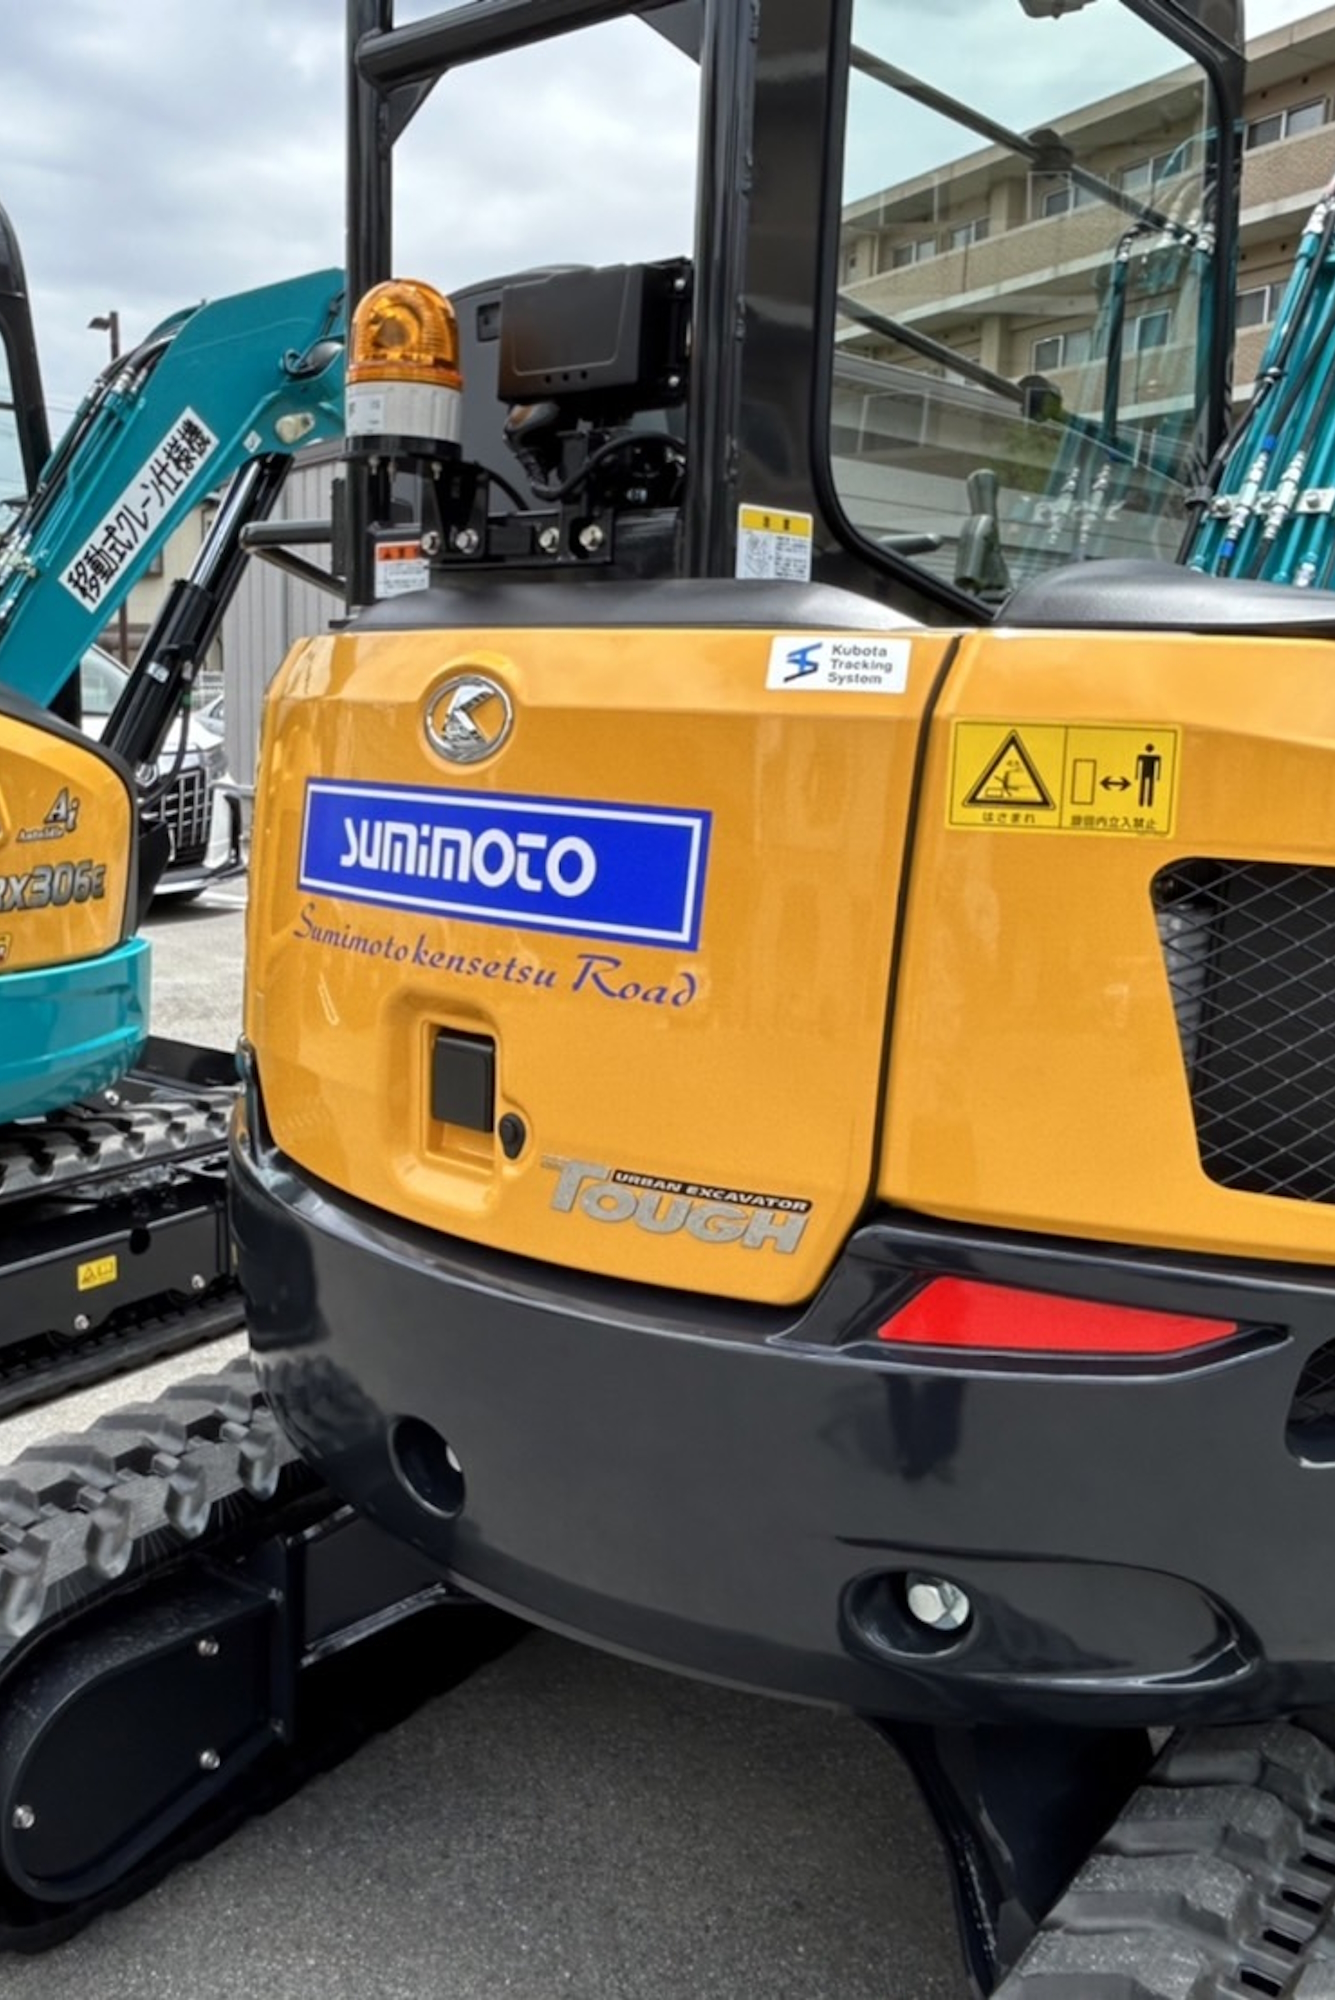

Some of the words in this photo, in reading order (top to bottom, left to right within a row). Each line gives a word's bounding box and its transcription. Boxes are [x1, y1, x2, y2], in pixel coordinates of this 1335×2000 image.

[68, 419, 211, 603] 移動式クレーン仕様機
[830, 658, 893, 672] Tracking
[831, 644, 888, 657] Kubota
[828, 672, 882, 685] System
[572, 953, 697, 1008] Road
[544, 1156, 810, 1255] TOUGH
[614, 1171, 682, 1194] URBAN
[686, 1186, 809, 1213] EXCAVATOR
